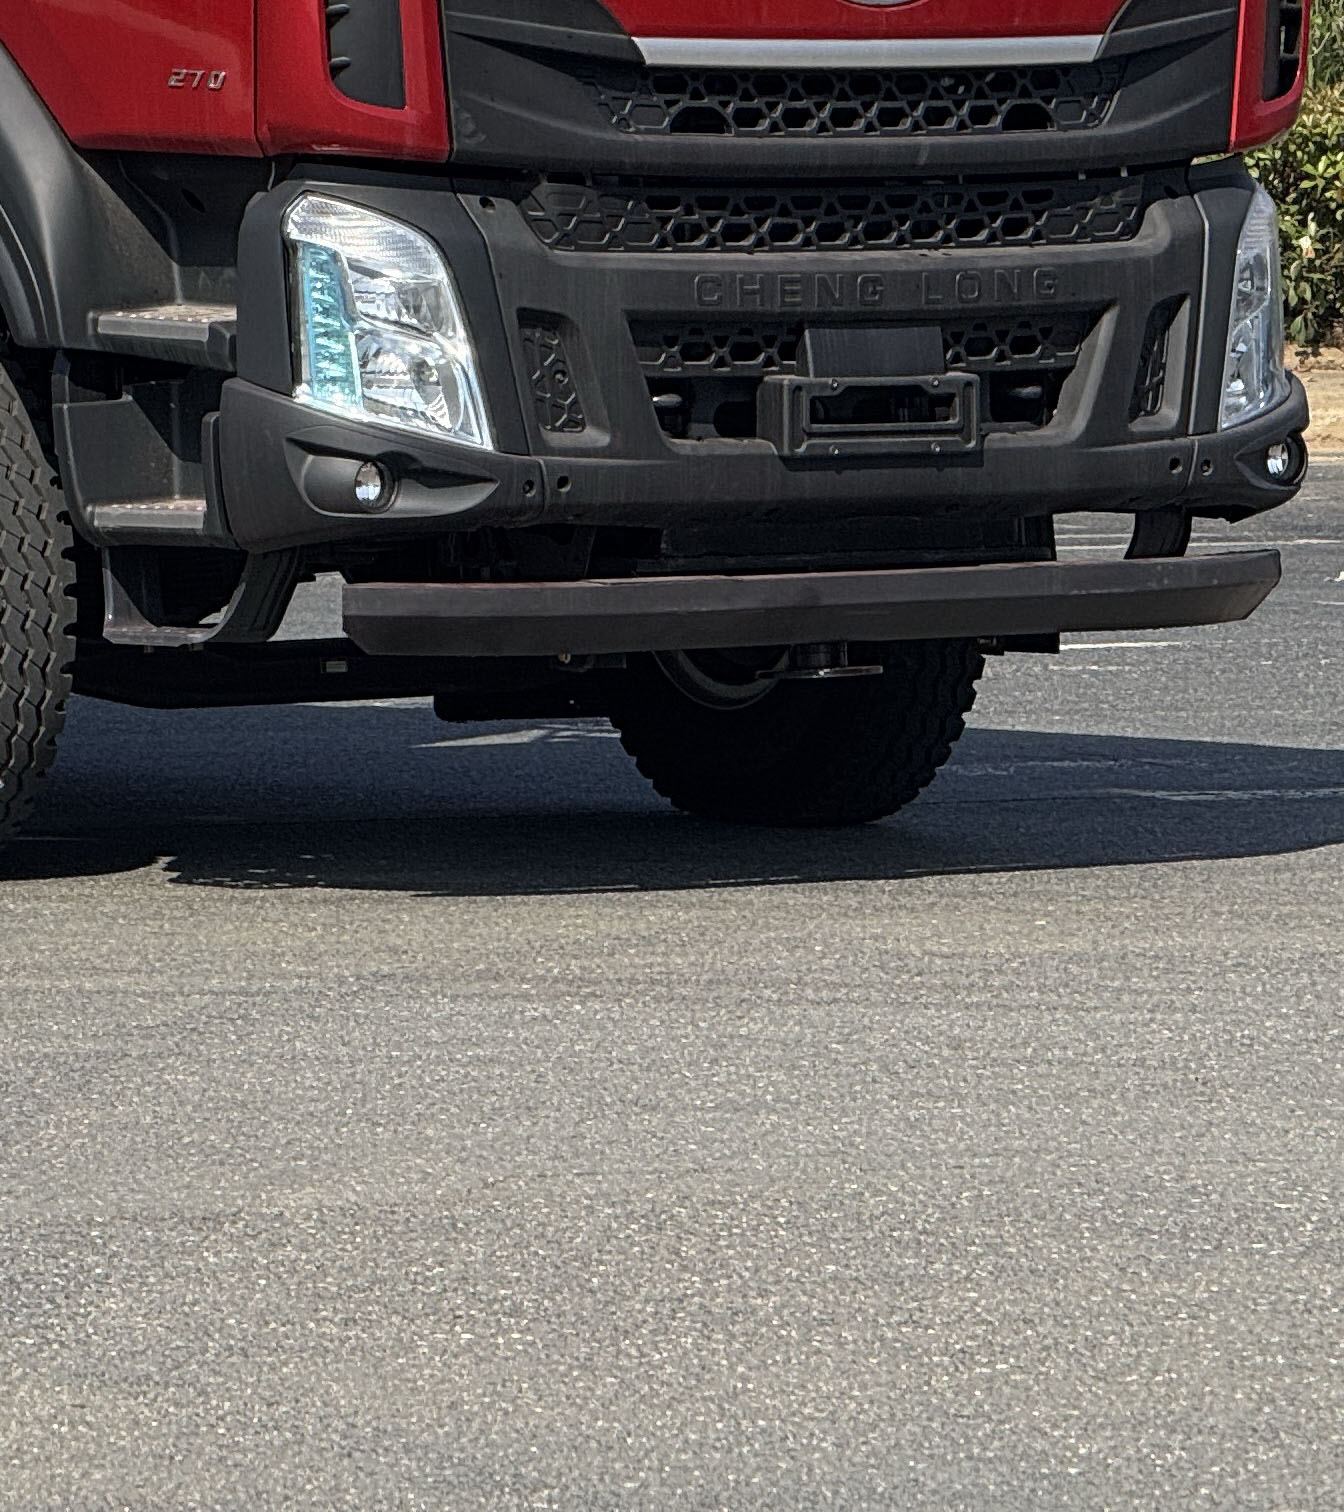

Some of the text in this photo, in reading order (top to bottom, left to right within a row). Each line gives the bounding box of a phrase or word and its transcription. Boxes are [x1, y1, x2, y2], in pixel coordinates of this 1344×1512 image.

[167, 67, 227, 90] 270
[693, 267, 1060, 308] CHENG LONG
